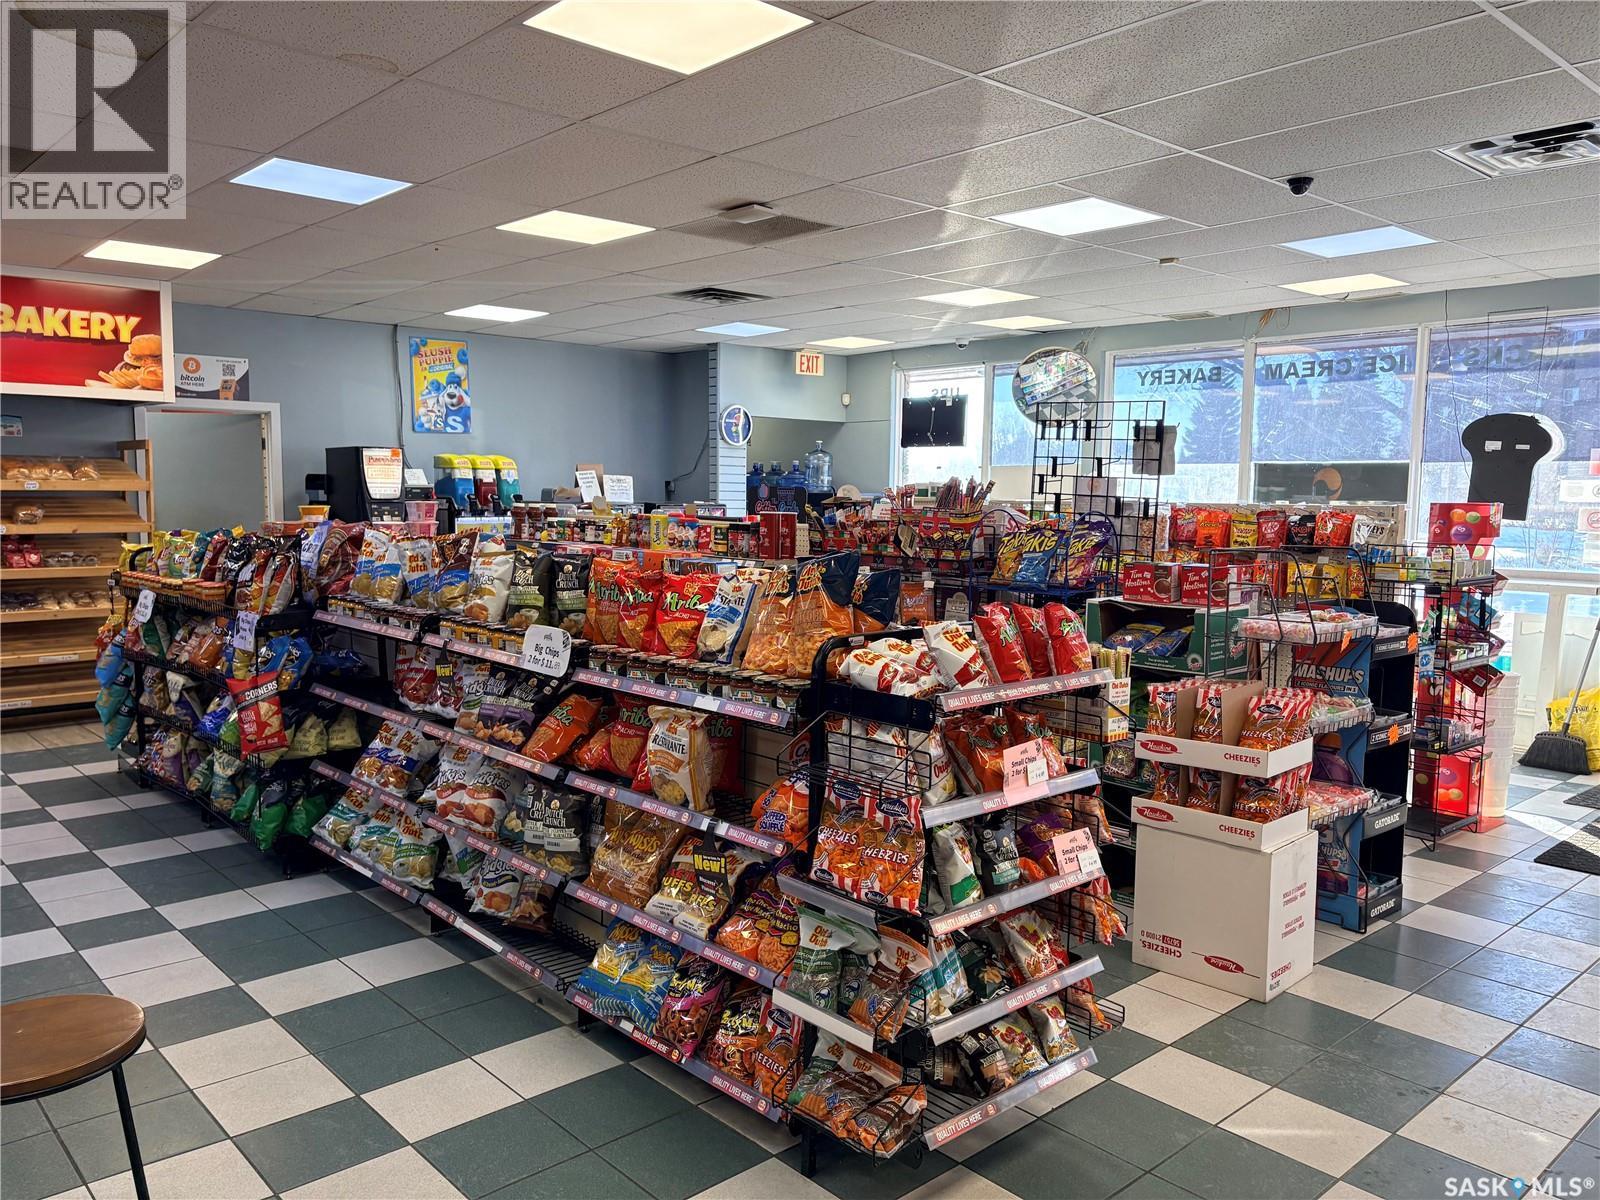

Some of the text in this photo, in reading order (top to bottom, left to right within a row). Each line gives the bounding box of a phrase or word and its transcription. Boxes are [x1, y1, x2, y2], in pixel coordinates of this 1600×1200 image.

[418, 347, 452, 358] SLUSH
[419, 355, 455, 366] PUPPIE
[799, 354, 820, 374] EXIT
[180, 374, 206, 383] bitcoin
[1129, 569, 1142, 579] Tim
[1187, 571, 1200, 581] Tim
[555, 579, 579, 589] CRUNCH
[1125, 578, 1151, 588] Hortons
[1183, 581, 1208, 591] Hortons
[528, 654, 533, 664] 2
[532, 655, 541, 665] for
[535, 643, 560, 660] Big Chips
[578, 672, 609, 685] QUALITY LIVES HERE
[245, 680, 278, 701] CORNERS
[632, 684, 666, 697] QUALITY LIVES HERE
[948, 691, 995, 708] QUALITY LIVES HERE
[724, 702, 765, 719] QUALITY LIVES HERE
[1146, 741, 1172, 754] Hawkins
[1011, 756, 1037, 769] Small Chips
[1223, 751, 1261, 766] CHEEZIES
[574, 777, 607, 793] QUALITY LIVES HERE
[546, 809, 564, 820] DUTCH
[642, 799, 678, 818] QUALITY LIVES HERE
[1143, 806, 1168, 820] Hawkins
[544, 816, 566, 828] CRUNCH
[1374, 812, 1401, 829] GATORADE
[727, 826, 769, 850] QUALITY LIVES HERE
[818, 825, 857, 845] CHEEZIES
[1218, 823, 1256, 839] CHEEZIES
[1062, 844, 1088, 856] Small Chips
[694, 854, 726, 873] New!
[1064, 857, 1068, 865] 2
[576, 888, 608, 911] QUALITY LIVES HERE
[1370, 898, 1396, 918] GATORADE
[632, 914, 648, 928] QUALITY
[648, 920, 658, 932] LIVES
[658, 924, 669, 937] HERE
[935, 909, 981, 932] QUALITY LIVES HERE
[704, 946, 744, 970] QUALITY LIVES HERE
[1006, 984, 1048, 1008] QUALITY LIVES HERE
[632, 1028, 668, 1054] QUALITY LIVES HERE
[712, 1074, 753, 1104] QUALITY LIVES HERE
[936, 1111, 982, 1142] QUALITY LIVES HERE
